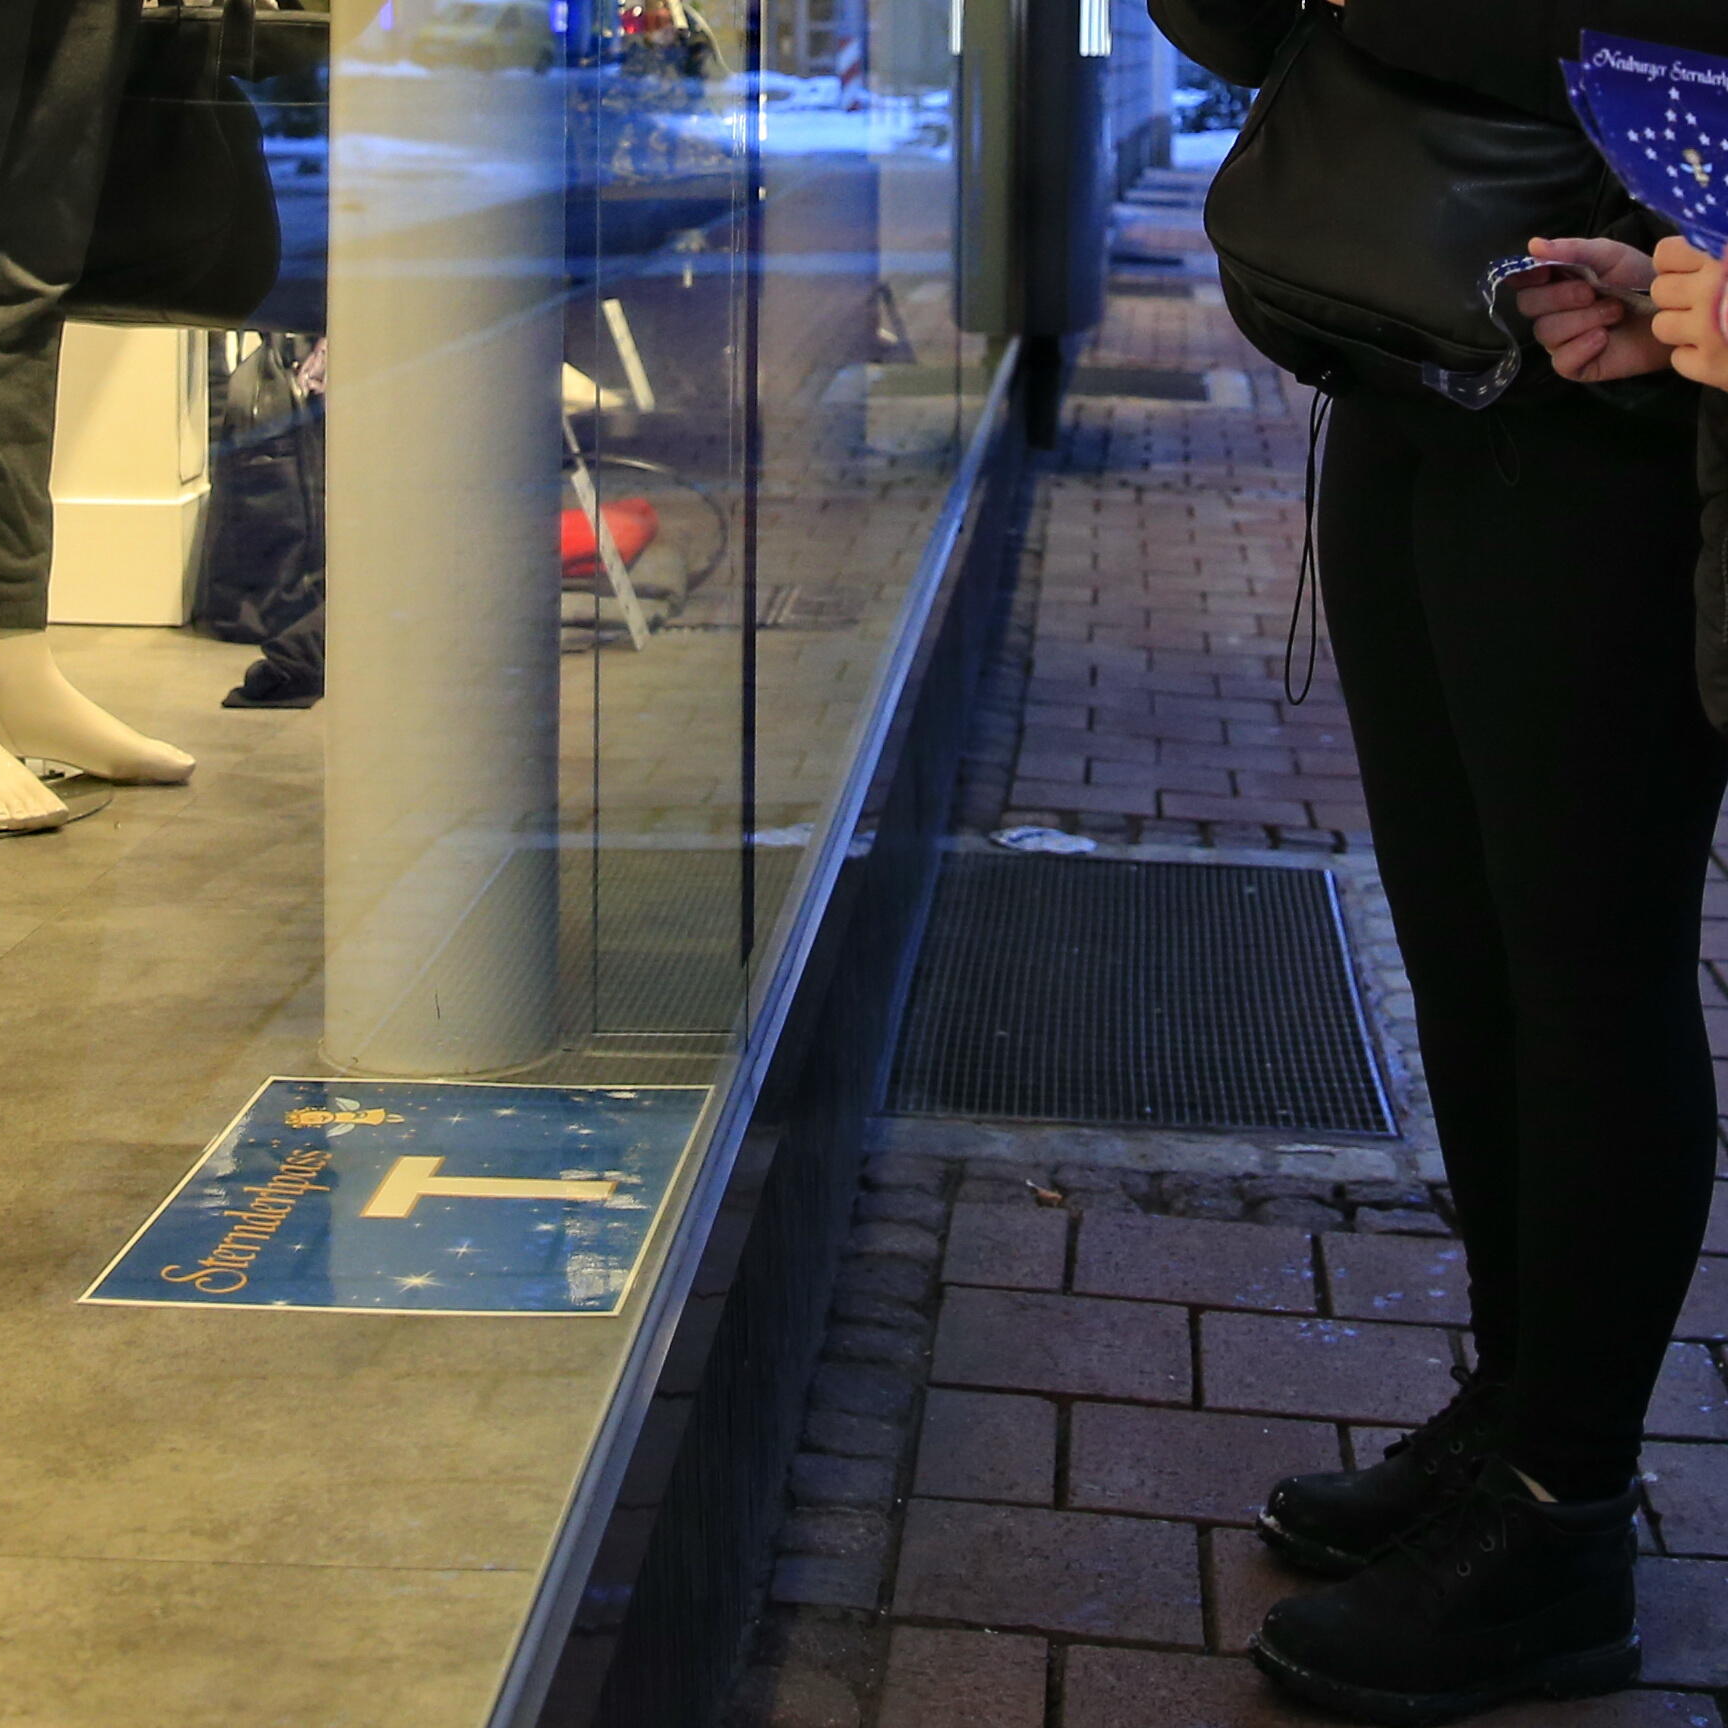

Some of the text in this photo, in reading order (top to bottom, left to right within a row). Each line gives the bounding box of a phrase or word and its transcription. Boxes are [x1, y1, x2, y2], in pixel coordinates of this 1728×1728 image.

[1592, 47, 1668, 82] Neuburger
[358, 1155, 618, 1218] T
[161, 1148, 333, 1295] Sternderlpass
